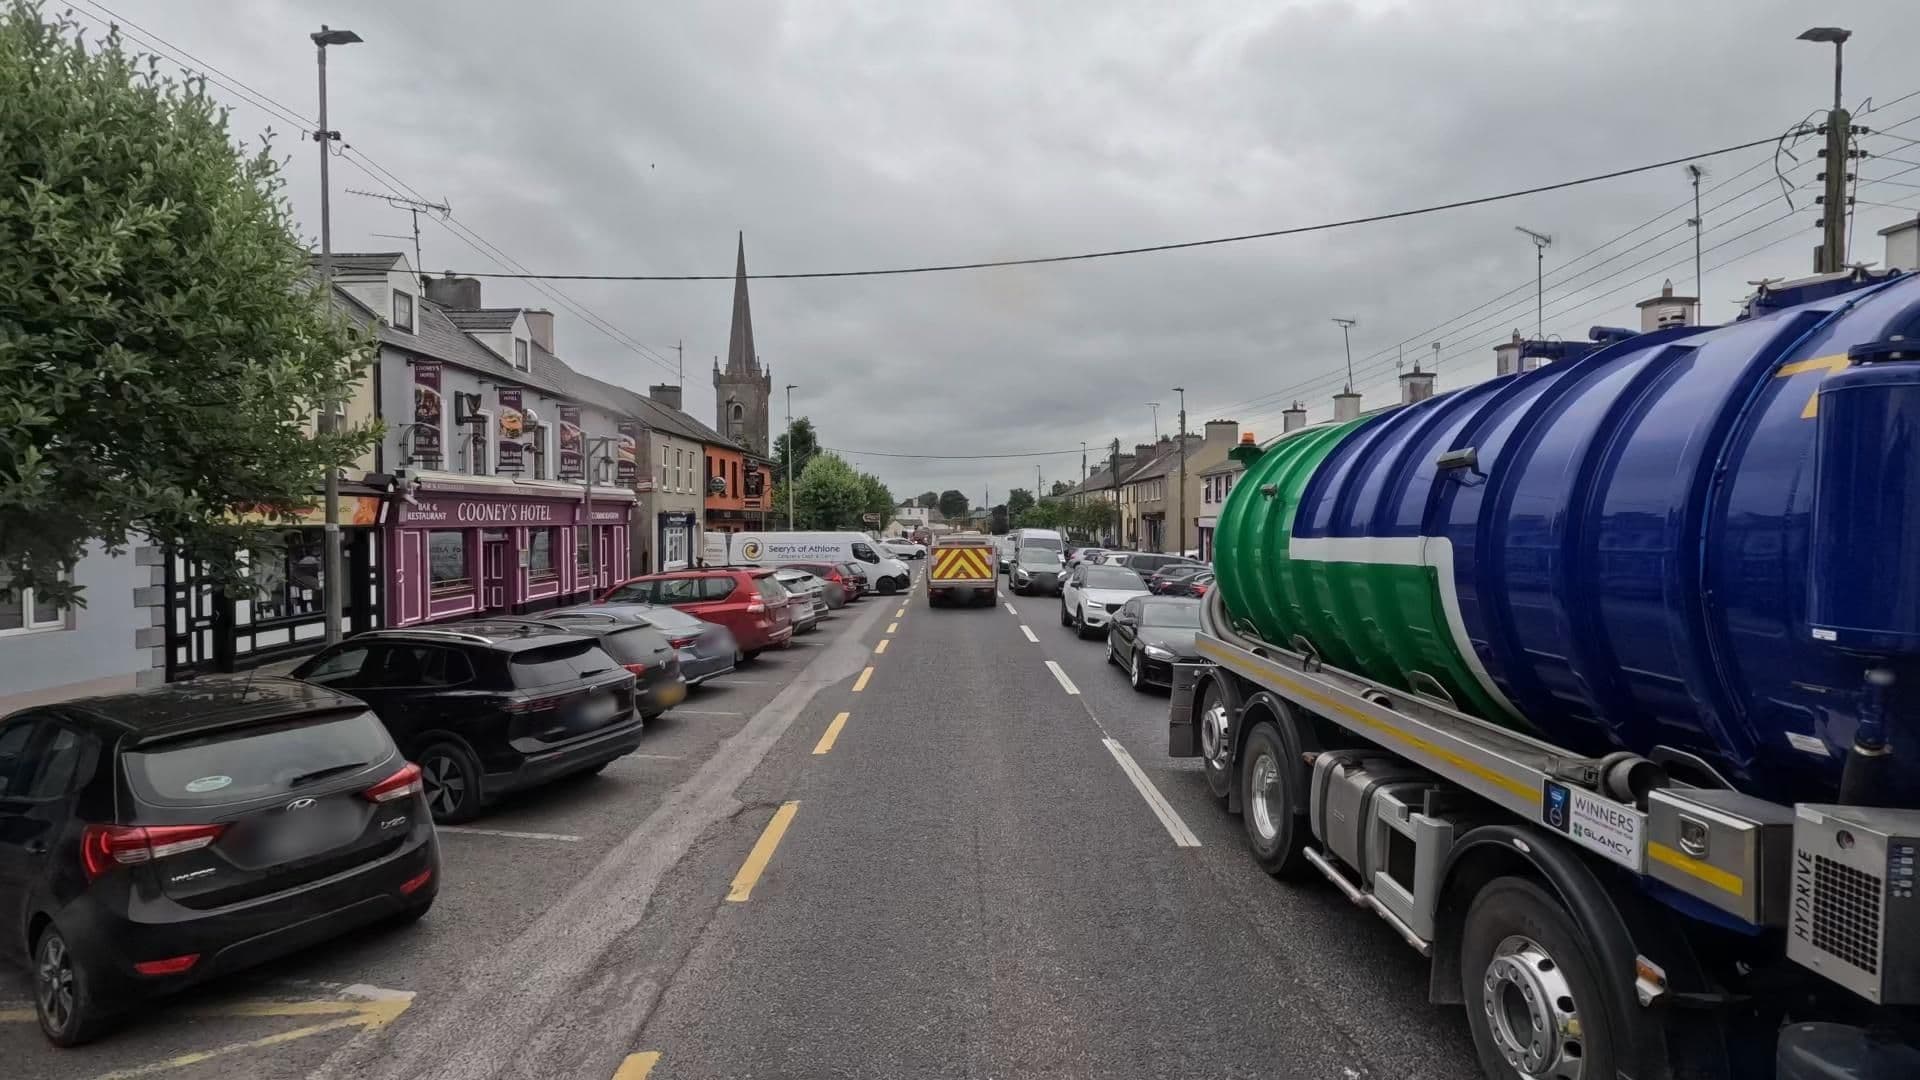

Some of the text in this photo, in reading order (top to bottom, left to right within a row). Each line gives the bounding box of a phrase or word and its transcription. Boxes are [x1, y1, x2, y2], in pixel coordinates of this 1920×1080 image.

[407, 511, 447, 520] RESTAURANT
[457, 502, 552, 522] COONEY'S HOTEL
[768, 544, 841, 554] Seery's of Athlone
[1575, 794, 1634, 833] WINNERS
[1583, 827, 1632, 857] GLANCY
[1794, 848, 1812, 942] HYDRIVE
